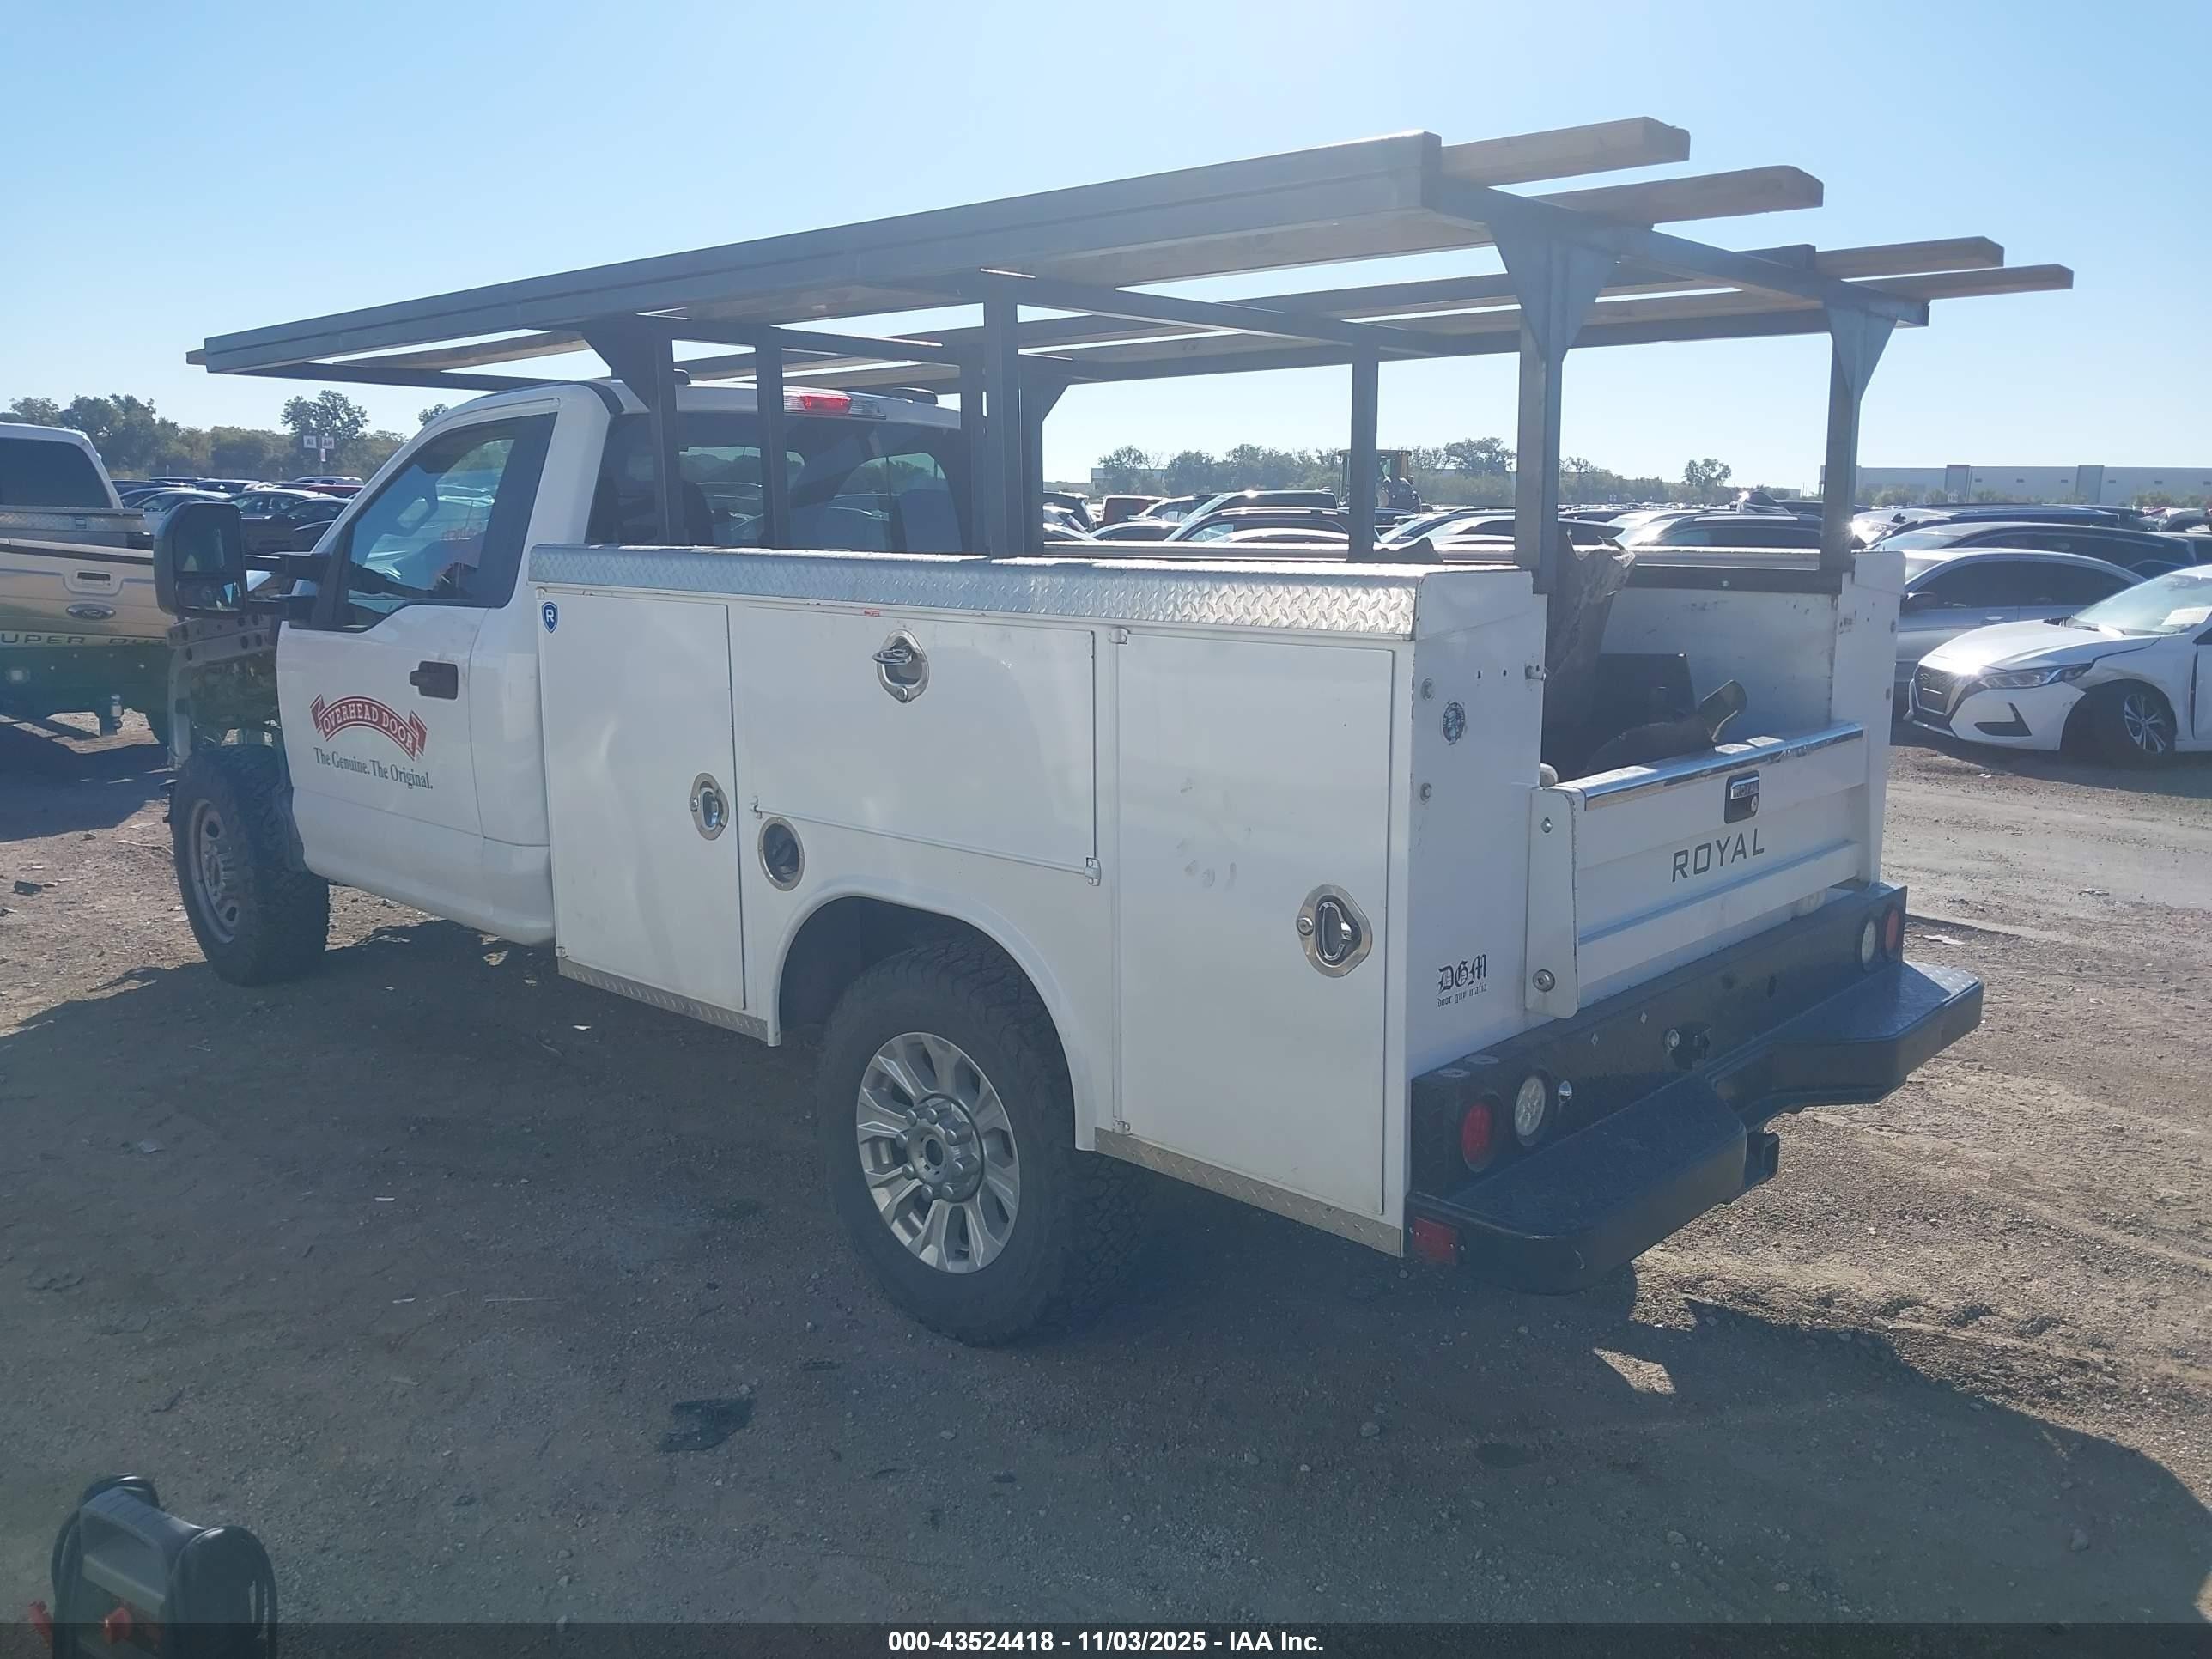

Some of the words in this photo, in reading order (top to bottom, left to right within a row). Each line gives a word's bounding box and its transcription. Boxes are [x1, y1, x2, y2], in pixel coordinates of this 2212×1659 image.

[545, 609, 555, 623] R
[0, 634, 86, 645] UPER
[323, 702, 379, 732] OVERHEAD
[381, 711, 415, 752] DOOR
[313, 747, 331, 766] The
[331, 751, 370, 775] Genuine.
[369, 759, 389, 780] The
[391, 763, 434, 789] Original.
[1672, 828, 1765, 883] ROYAL
[1437, 953, 1487, 994] DGM
[1437, 995, 1453, 1007] door
